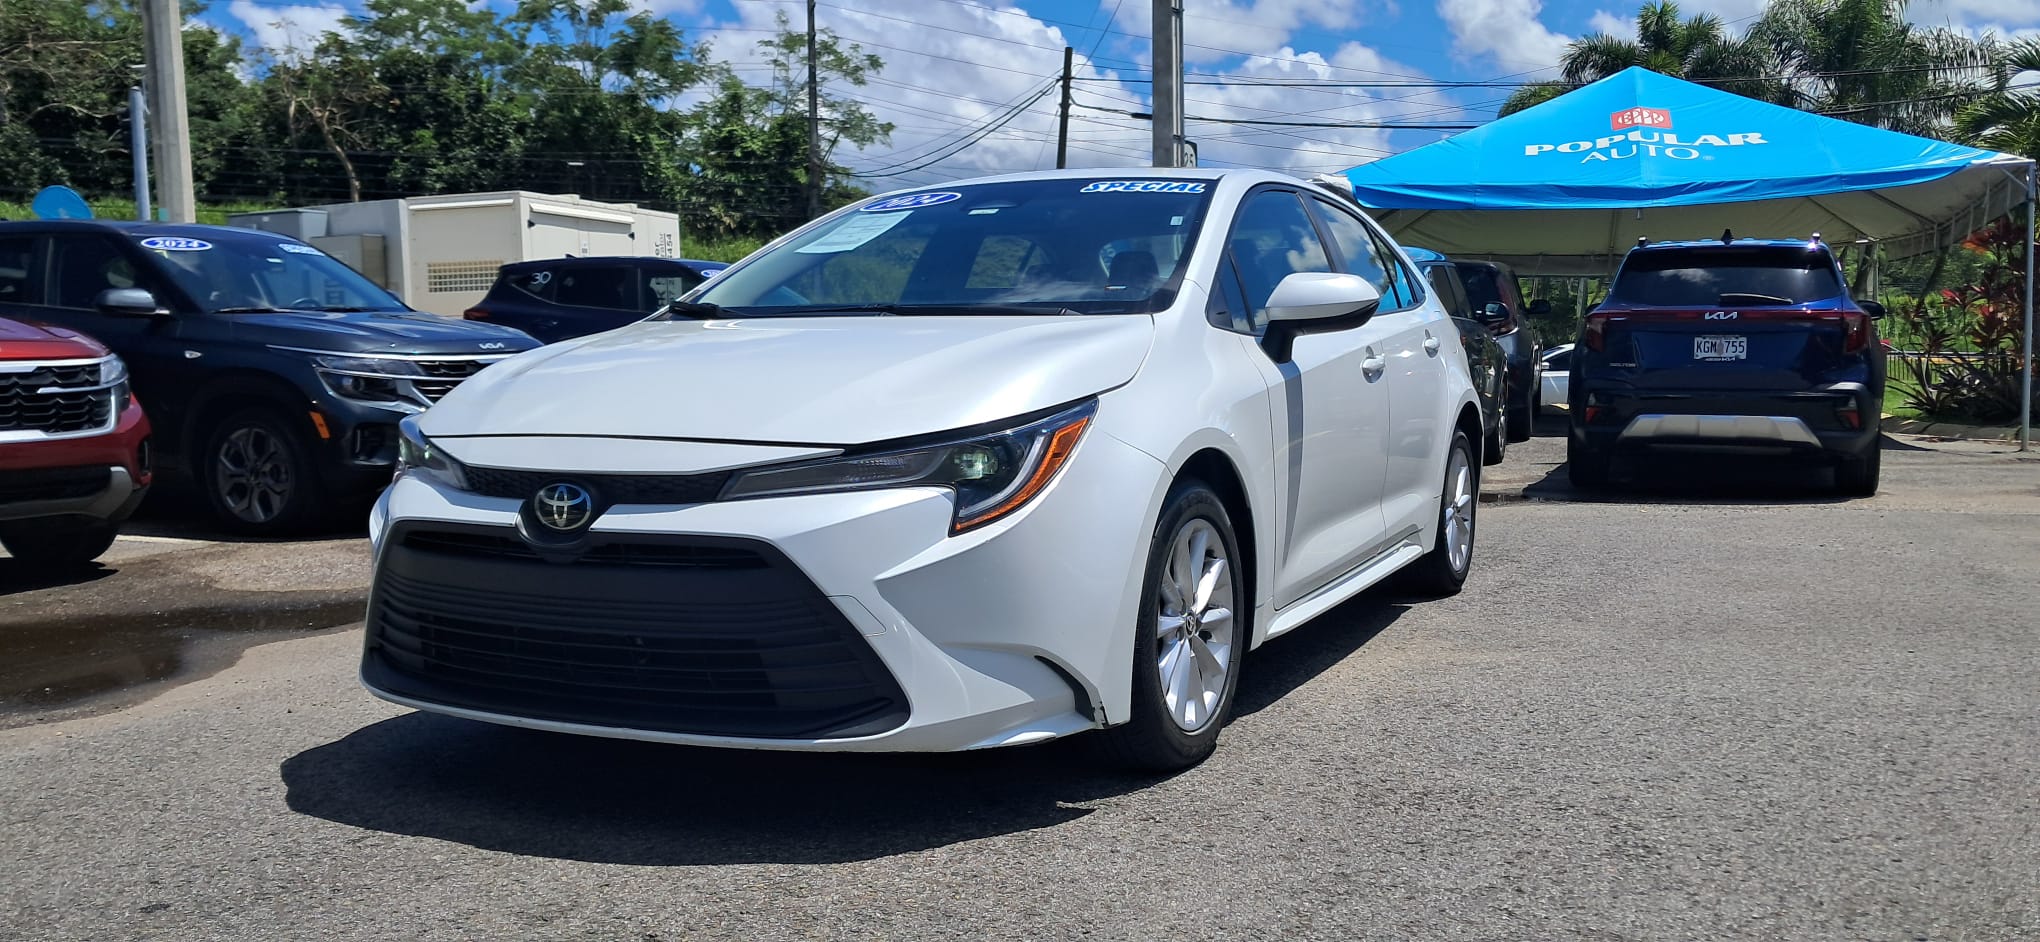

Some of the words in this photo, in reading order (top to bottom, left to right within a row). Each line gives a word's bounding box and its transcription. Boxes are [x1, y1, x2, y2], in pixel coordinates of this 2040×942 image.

[1525, 130, 1768, 156] POPULAR
[1581, 143, 1700, 164] AUTO
[1080, 181, 1206, 194] SPECIAL
[152, 239, 200, 249] 2024
[530, 271, 552, 285] 30
[1704, 311, 1738, 320] KIA
[1696, 340, 1717, 354] KGM
[1724, 340, 1745, 354] 755
